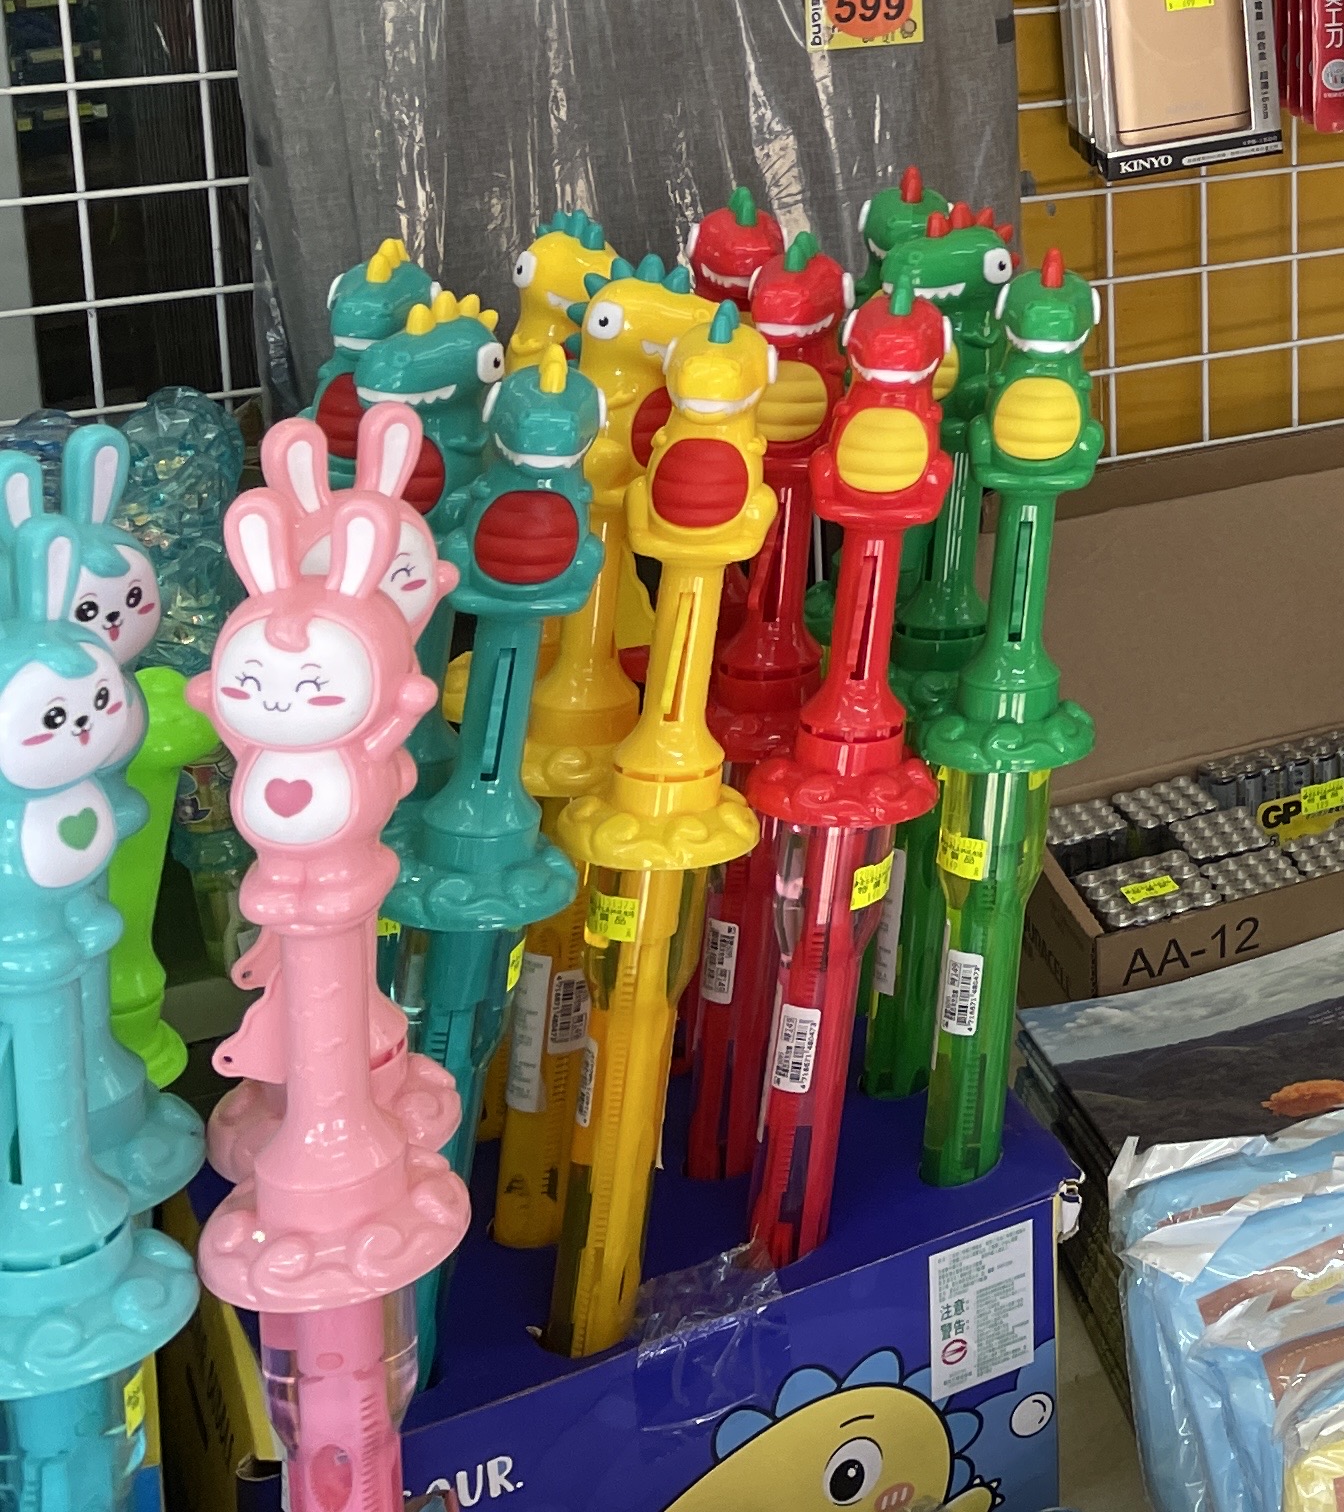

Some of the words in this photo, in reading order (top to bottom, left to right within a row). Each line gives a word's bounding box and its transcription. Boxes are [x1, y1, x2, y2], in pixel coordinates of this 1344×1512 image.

[1119, 154, 1173, 174] KINYO
[1261, 799, 1302, 829] GP
[1123, 916, 1261, 986] AA-12
